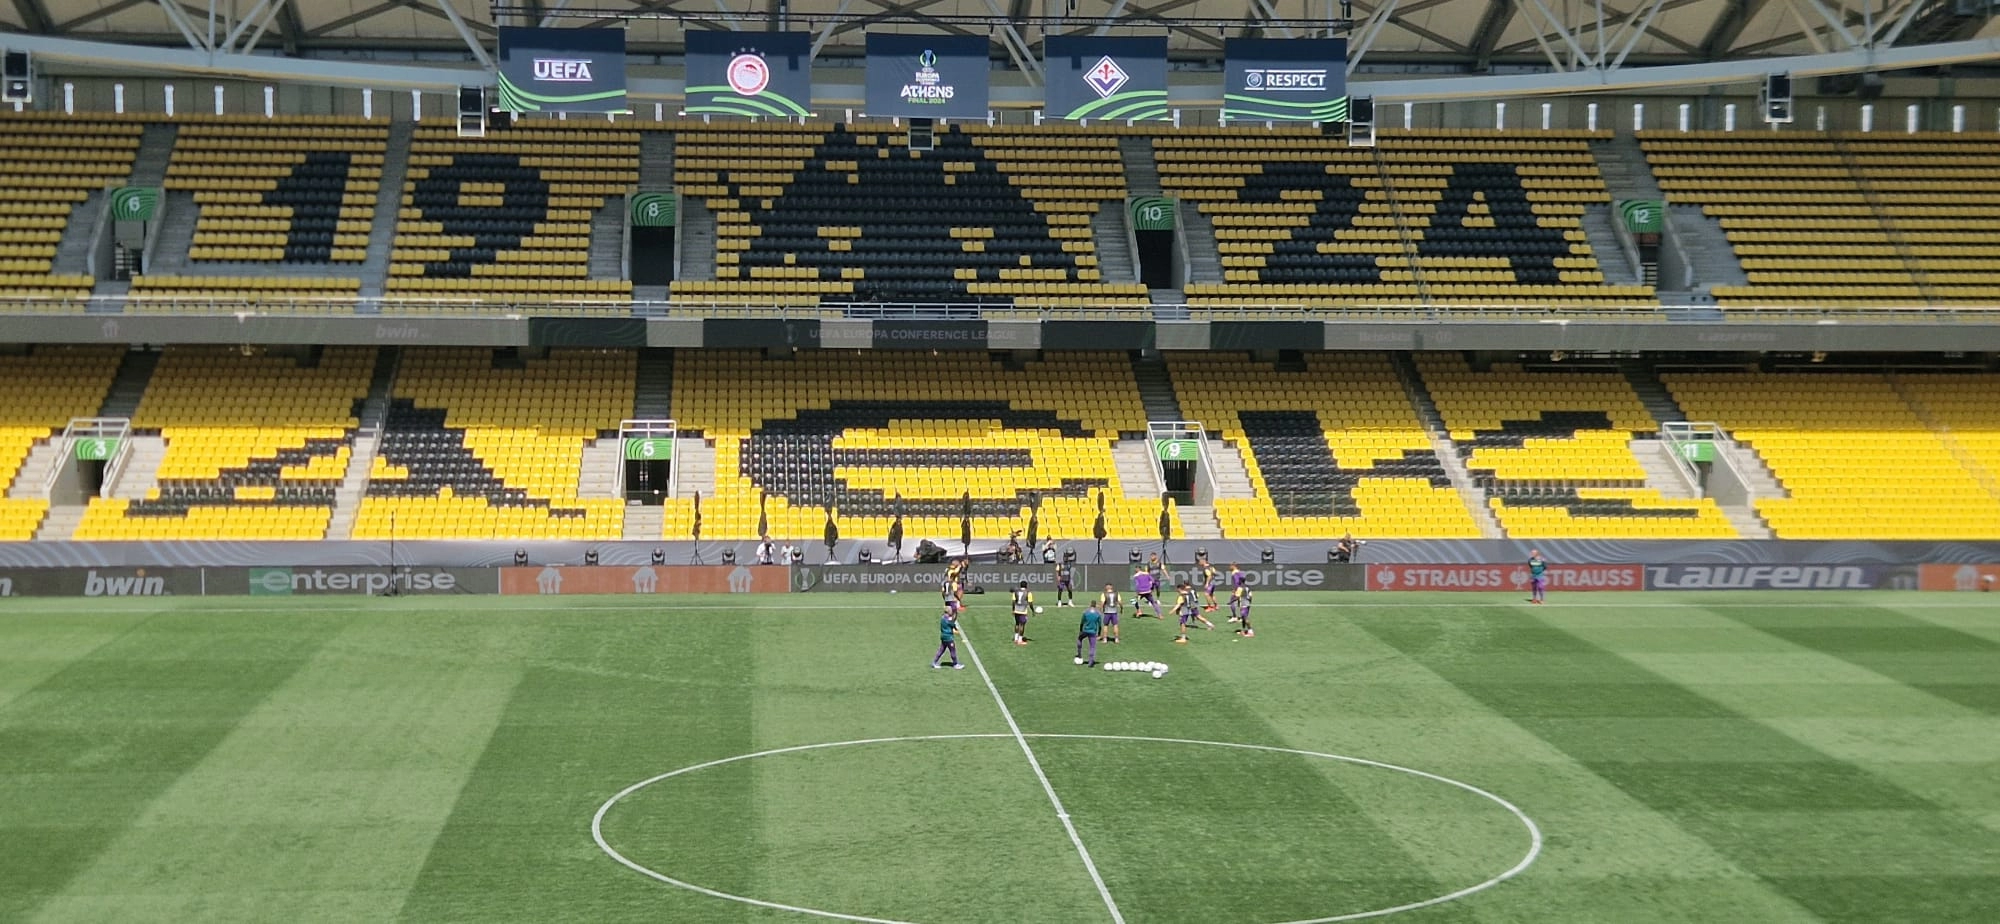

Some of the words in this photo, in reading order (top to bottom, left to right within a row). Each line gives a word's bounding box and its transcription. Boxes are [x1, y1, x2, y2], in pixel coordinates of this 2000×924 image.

[535, 62, 591, 78] UEFA
[1266, 74, 1327, 87] RESPECT
[901, 85, 954, 98] ATHENS
[129, 197, 140, 211] 6
[648, 202, 659, 217] 8
[1143, 207, 1162, 221] 10
[1633, 209, 1649, 224] 12
[891, 329, 968, 339] CONFERENCE
[95, 440, 106, 457] 3
[643, 441, 655, 457] 5
[1169, 442, 1180, 457] 9
[1682, 443, 1698, 458] 11
[84, 568, 164, 596] bwin
[262, 567, 456, 594] enterprise
[823, 573, 857, 584] UEFA
[860, 573, 911, 584] EUROPA
[1003, 572, 1054, 584] LEAGUE
[1403, 569, 1502, 587] STRAUSS
[1648, 566, 1871, 588] Laufenn
